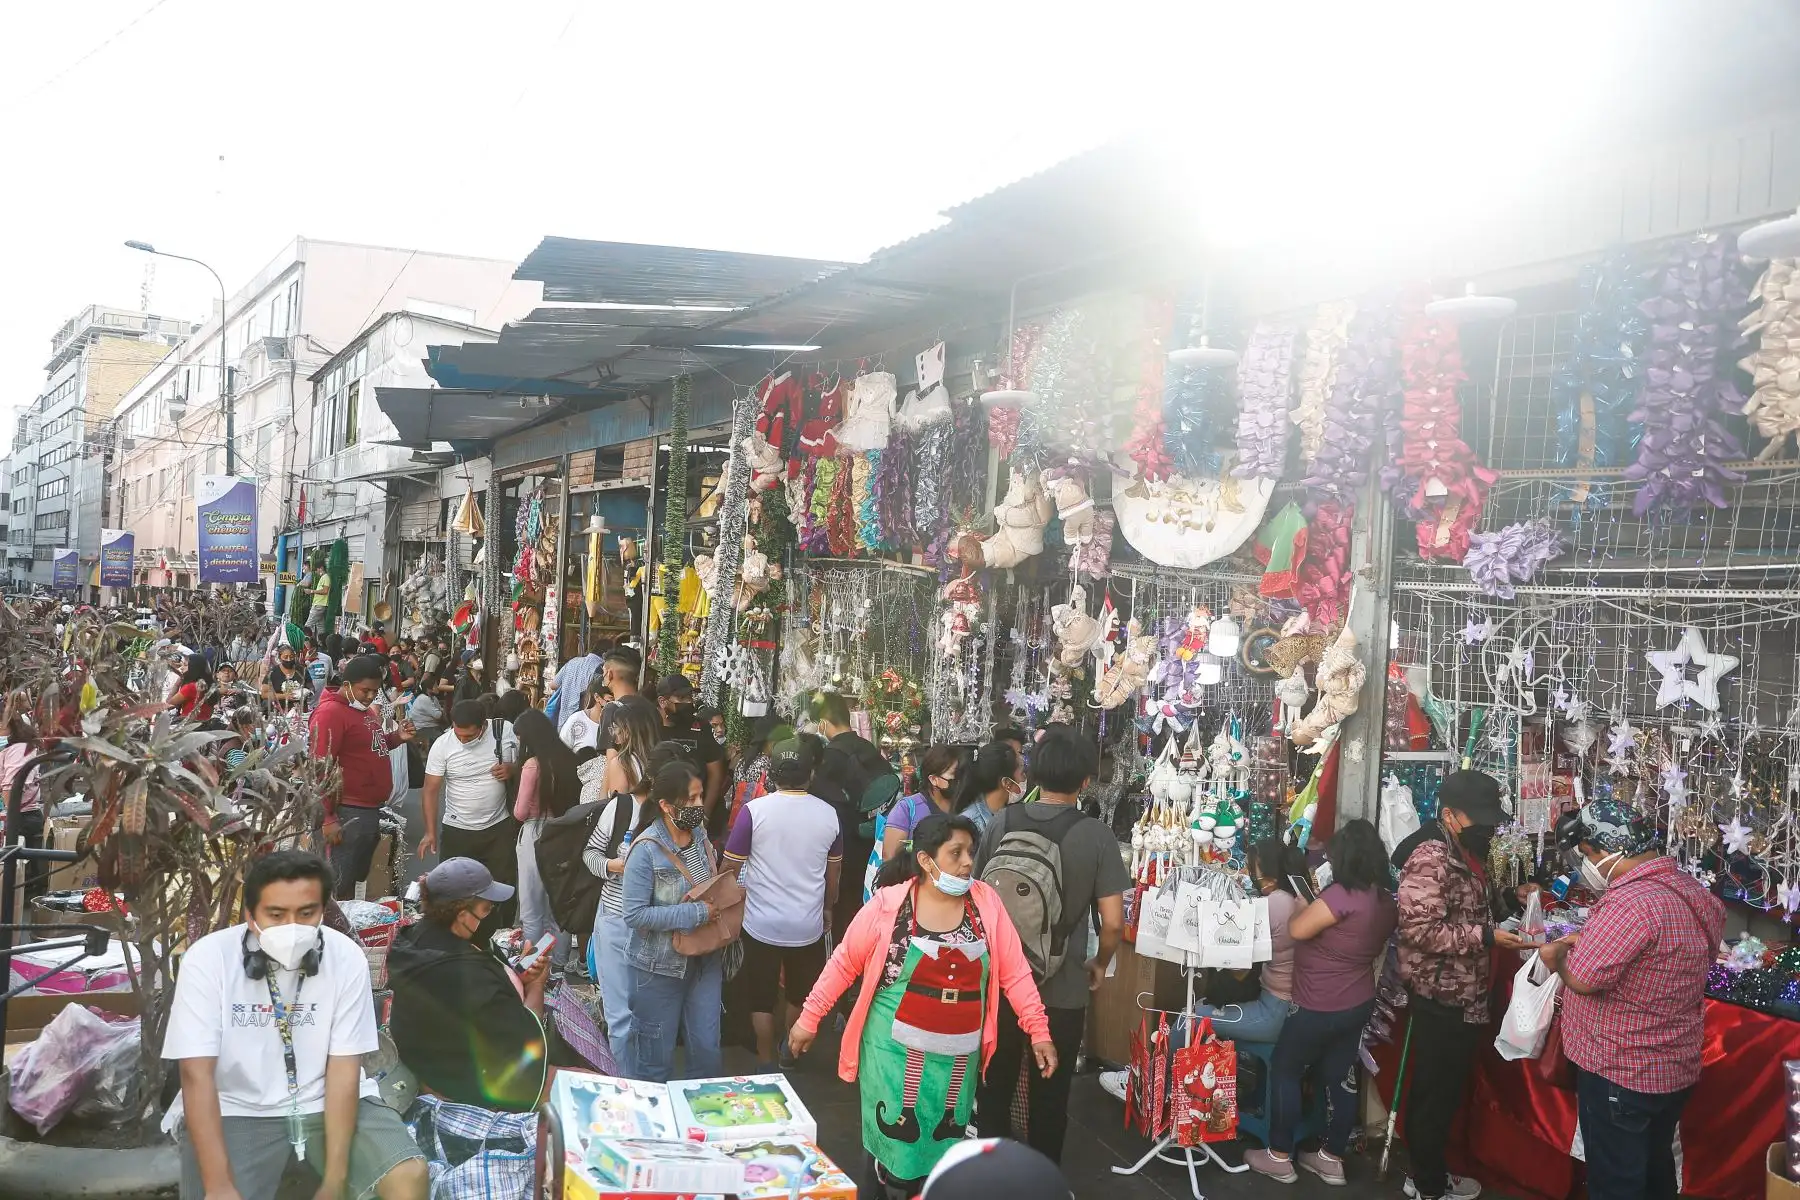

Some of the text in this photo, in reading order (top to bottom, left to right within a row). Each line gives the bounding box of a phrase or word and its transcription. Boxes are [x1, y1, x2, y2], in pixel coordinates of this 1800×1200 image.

[203, 510, 253, 525] Compra
[780, 751, 799, 760] NIKE
[231, 1012, 316, 1028] NAUTCA
